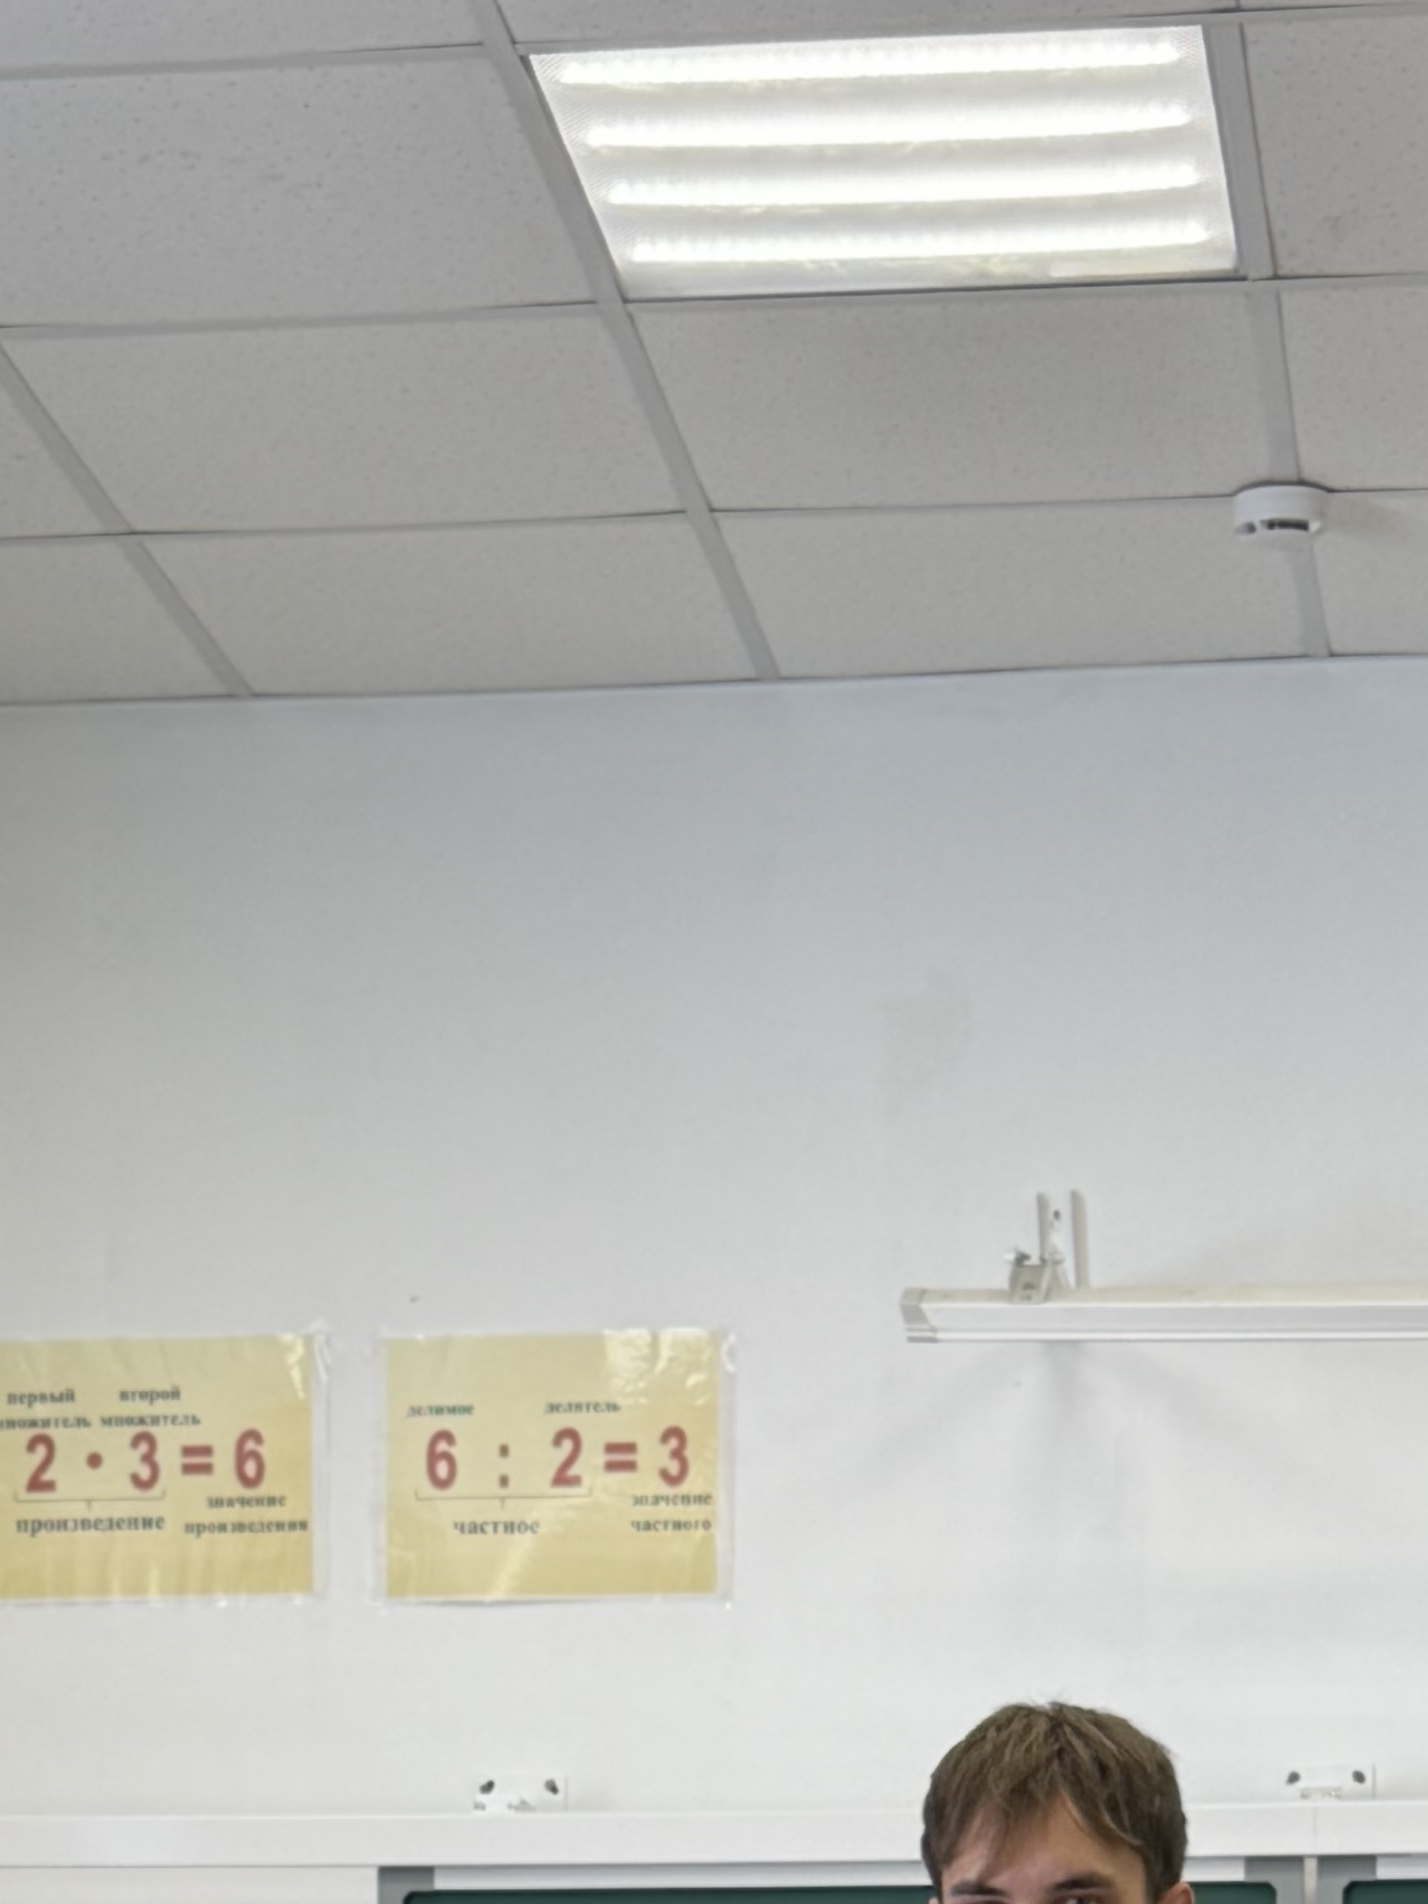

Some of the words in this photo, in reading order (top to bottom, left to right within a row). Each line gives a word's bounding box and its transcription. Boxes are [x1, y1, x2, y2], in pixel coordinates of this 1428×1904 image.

[7, 1388, 75, 1408] первый
[119, 1386, 181, 1405] второй
[407, 1404, 475, 1418] делимое
[544, 1401, 621, 1414] делитель
[99, 1414, 201, 1427] множитель
[207, 1494, 286, 1508] значение
[632, 1493, 713, 1506] значение
[16, 1516, 165, 1538] произведение
[184, 1520, 308, 1536] произведения
[454, 1521, 540, 1535] частное
[630, 1519, 712, 1534] частного
